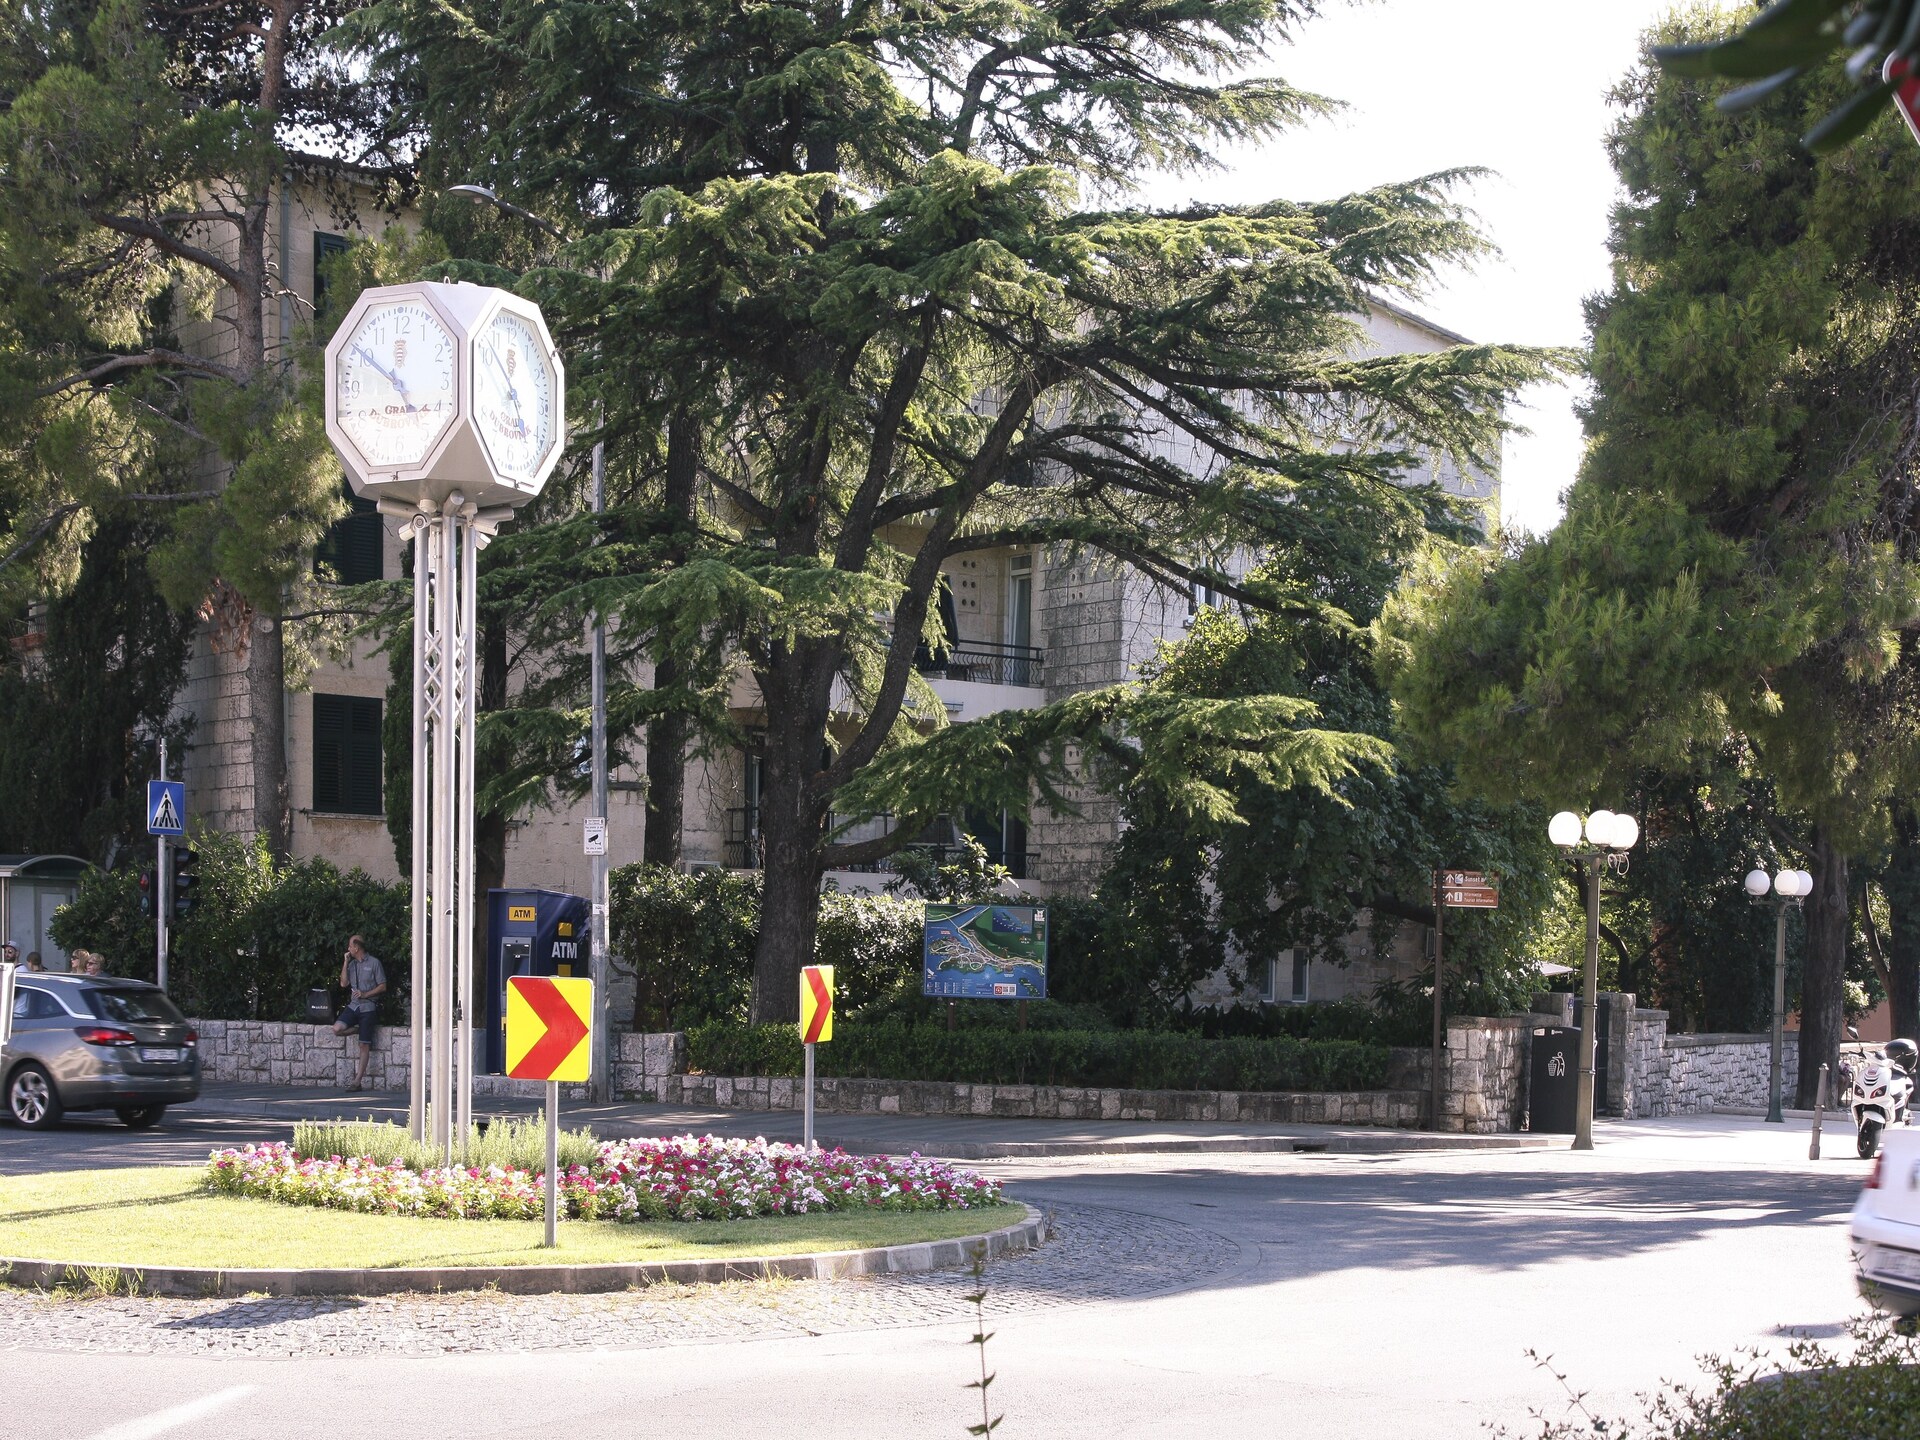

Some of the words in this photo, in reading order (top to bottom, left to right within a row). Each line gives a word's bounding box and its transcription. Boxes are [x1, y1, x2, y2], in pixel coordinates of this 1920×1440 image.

[393, 315, 411, 335] 12
[421, 324, 426, 342] 1
[373, 326, 385, 345] 11
[491, 330, 501, 350] 11
[506, 327, 518, 347] 12
[359, 347, 374, 368] 10
[434, 343, 444, 363] 2
[481, 347, 493, 367] 10
[440, 371, 450, 391] 3
[477, 373, 484, 393] 9
[533, 368, 541, 388] 2
[351, 380, 361, 399] 9
[384, 404, 414, 415] GRA
[433, 399, 443, 418] 4
[480, 405, 488, 425] 8
[538, 396, 545, 416] 3
[357, 409, 367, 430] 8
[489, 410, 532, 440] DUBROVNK
[375, 429, 383, 447] 7
[420, 422, 430, 441] 5
[492, 428, 498, 447] 7
[533, 425, 540, 443] 4
[395, 435, 405, 453] 6
[506, 443, 514, 462] 6
[513, 909, 531, 919] ATM
[551, 941, 578, 960] ATM
